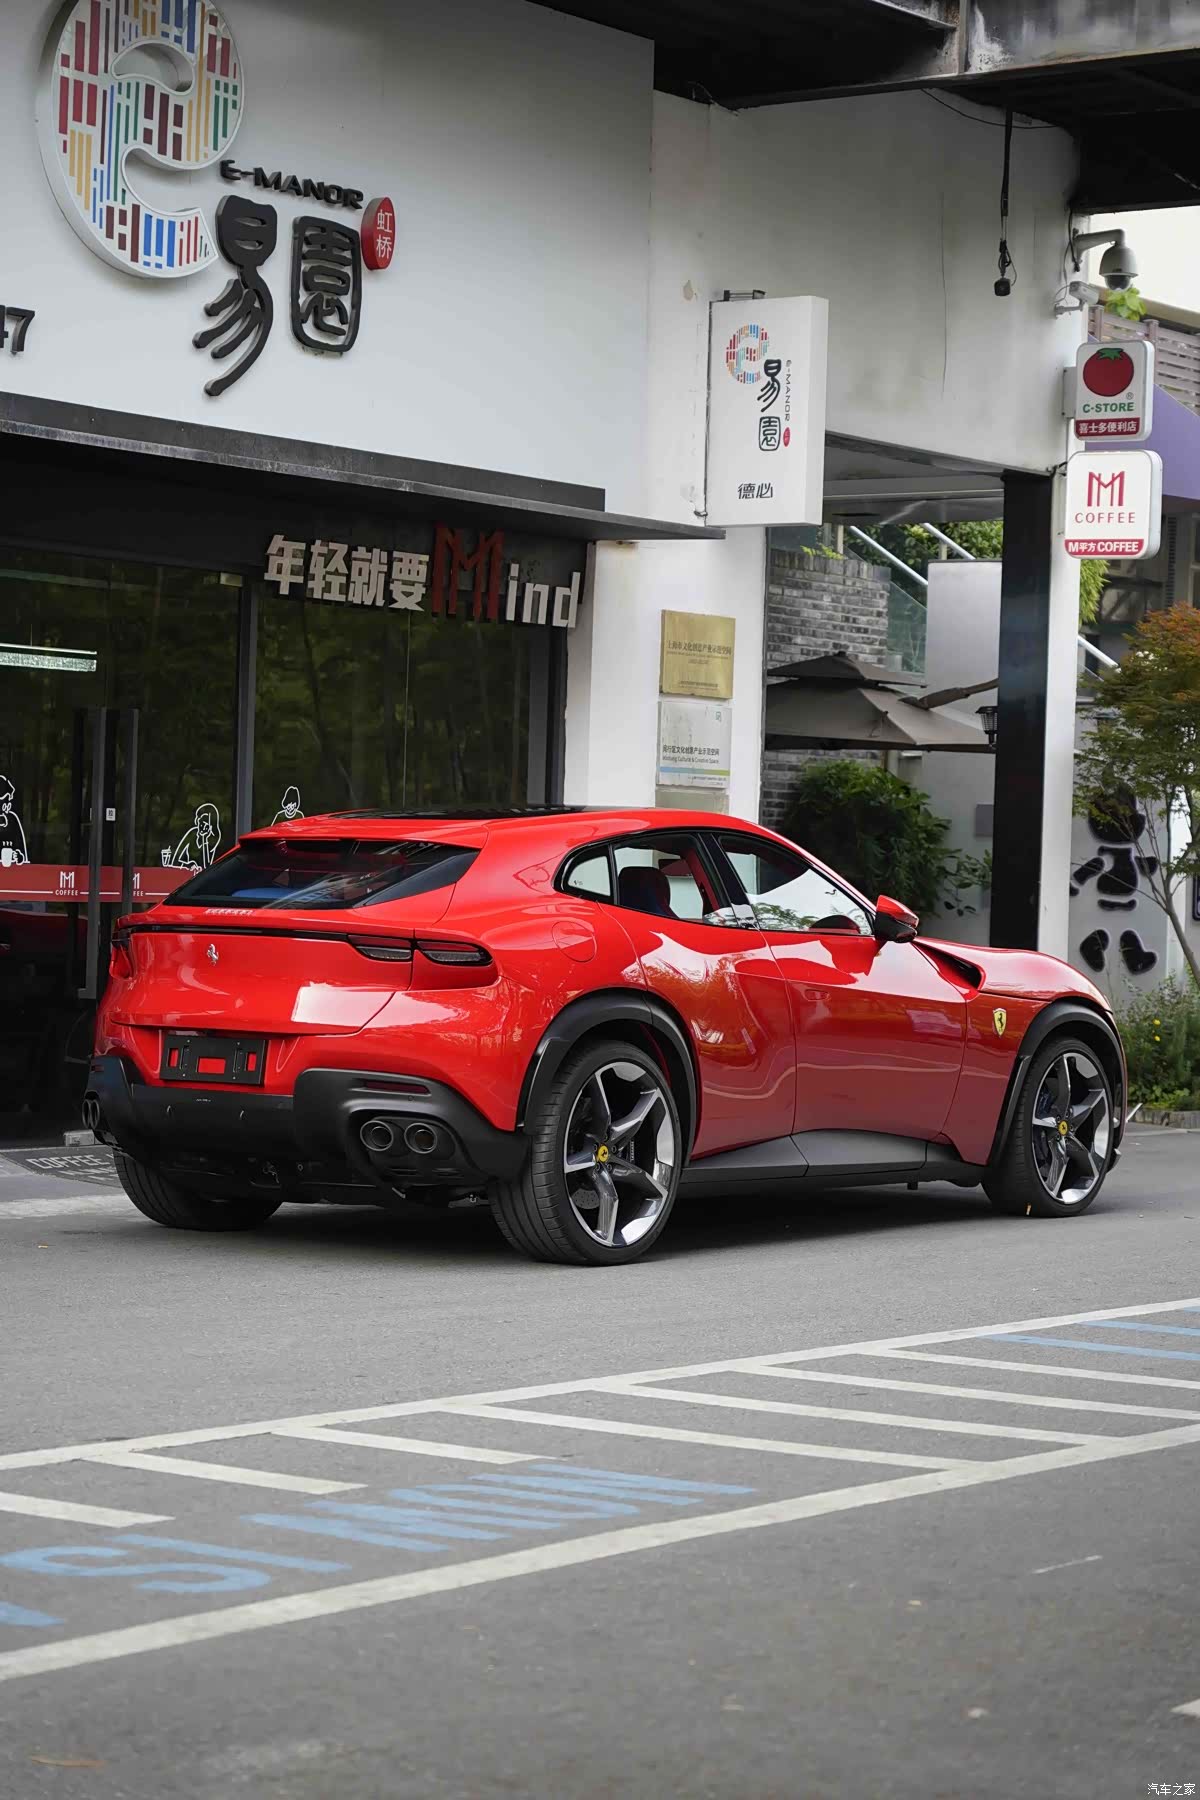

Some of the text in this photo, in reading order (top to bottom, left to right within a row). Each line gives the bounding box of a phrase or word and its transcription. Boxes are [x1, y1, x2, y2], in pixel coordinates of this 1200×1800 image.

[376, 209, 393, 260] 虹桥
[1082, 401, 1135, 414] C-STORE
[1079, 420, 1138, 434] 喜士多便利店
[737, 482, 774, 500] 德必
[1074, 511, 1136, 524] COFFEE
[25, 1154, 111, 1169] COFFEE
